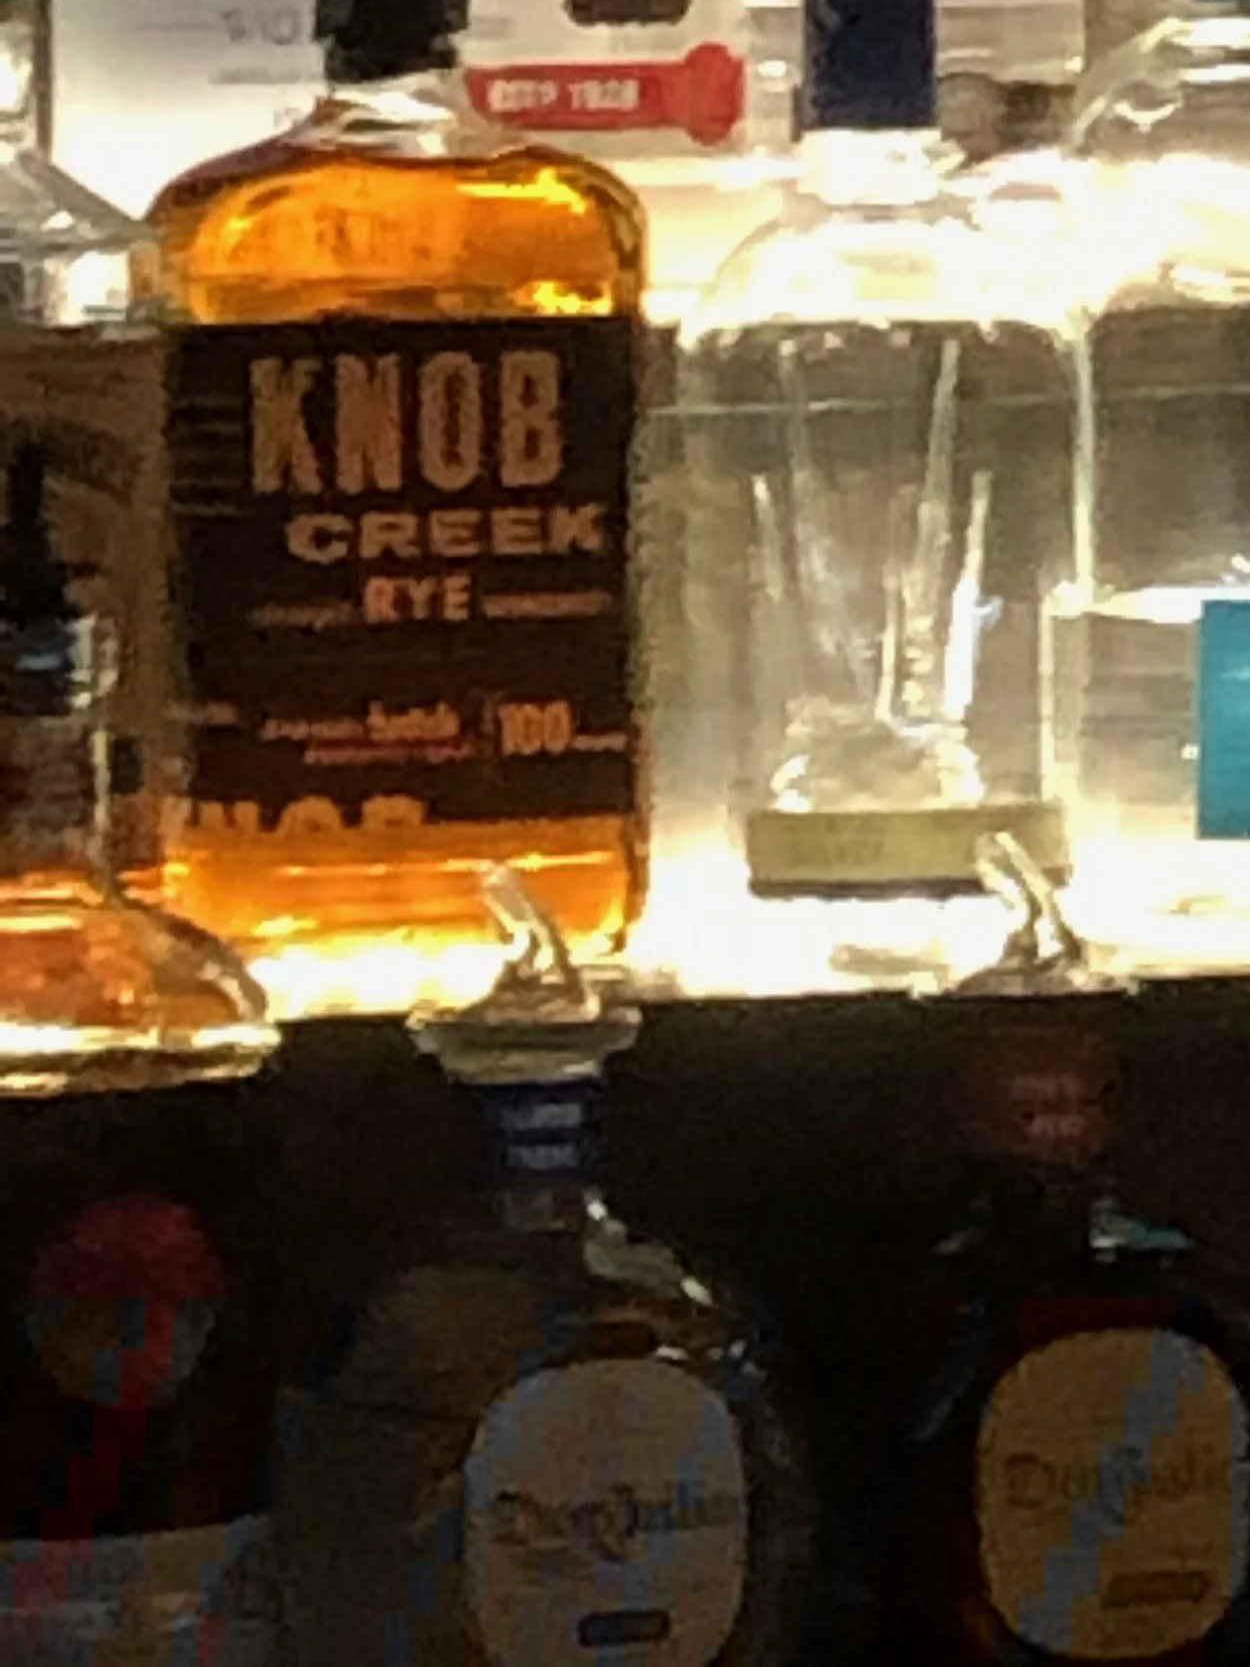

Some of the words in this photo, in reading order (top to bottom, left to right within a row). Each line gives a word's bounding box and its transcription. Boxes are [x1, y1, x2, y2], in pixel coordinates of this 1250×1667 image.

[249, 349, 565, 495] KNOB
[286, 503, 604, 564] CREEK
[361, 576, 471, 625] RYE
